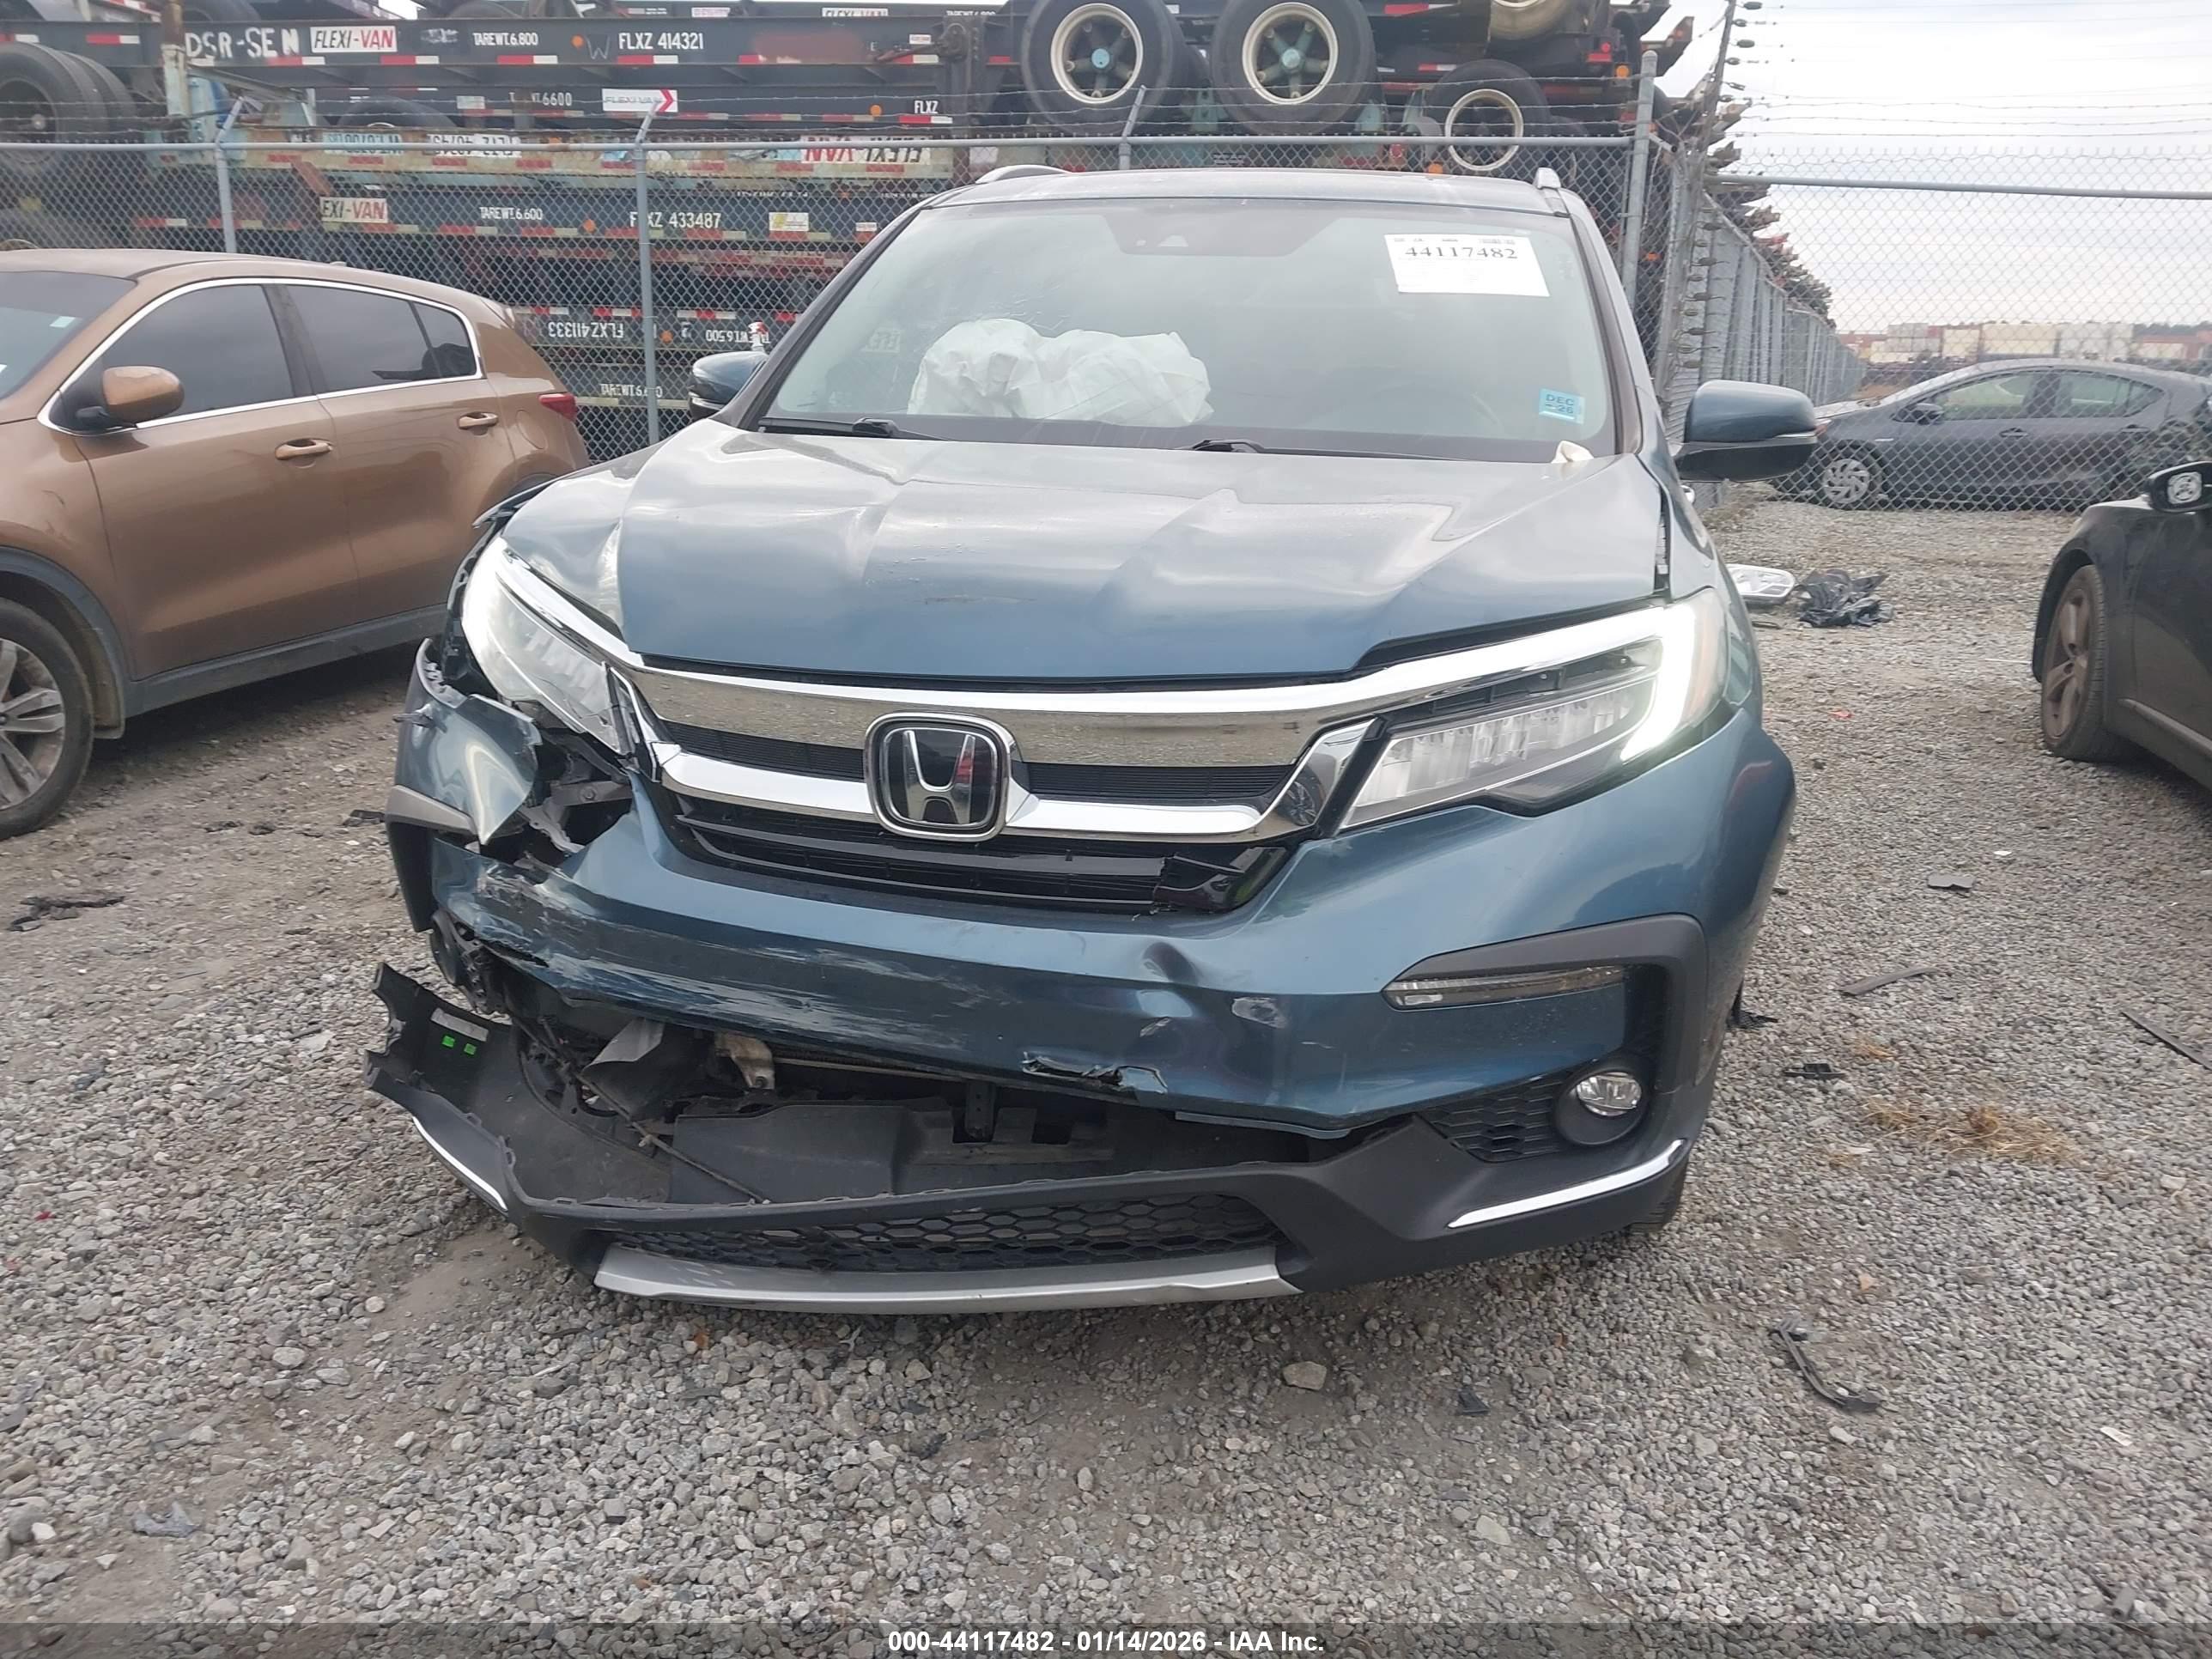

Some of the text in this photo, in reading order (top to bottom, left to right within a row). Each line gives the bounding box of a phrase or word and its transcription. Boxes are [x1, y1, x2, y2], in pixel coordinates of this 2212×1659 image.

[314, 30, 392, 49] FLEXI-VAN
[618, 33, 703, 49] FLXZ 414321
[915, 100, 939, 113] FLXZ
[321, 200, 386, 220] EXI-VAN
[629, 212, 721, 228] FXZ 433487
[1405, 246, 1518, 258] 44117482
[1546, 394, 1574, 406] DEC
